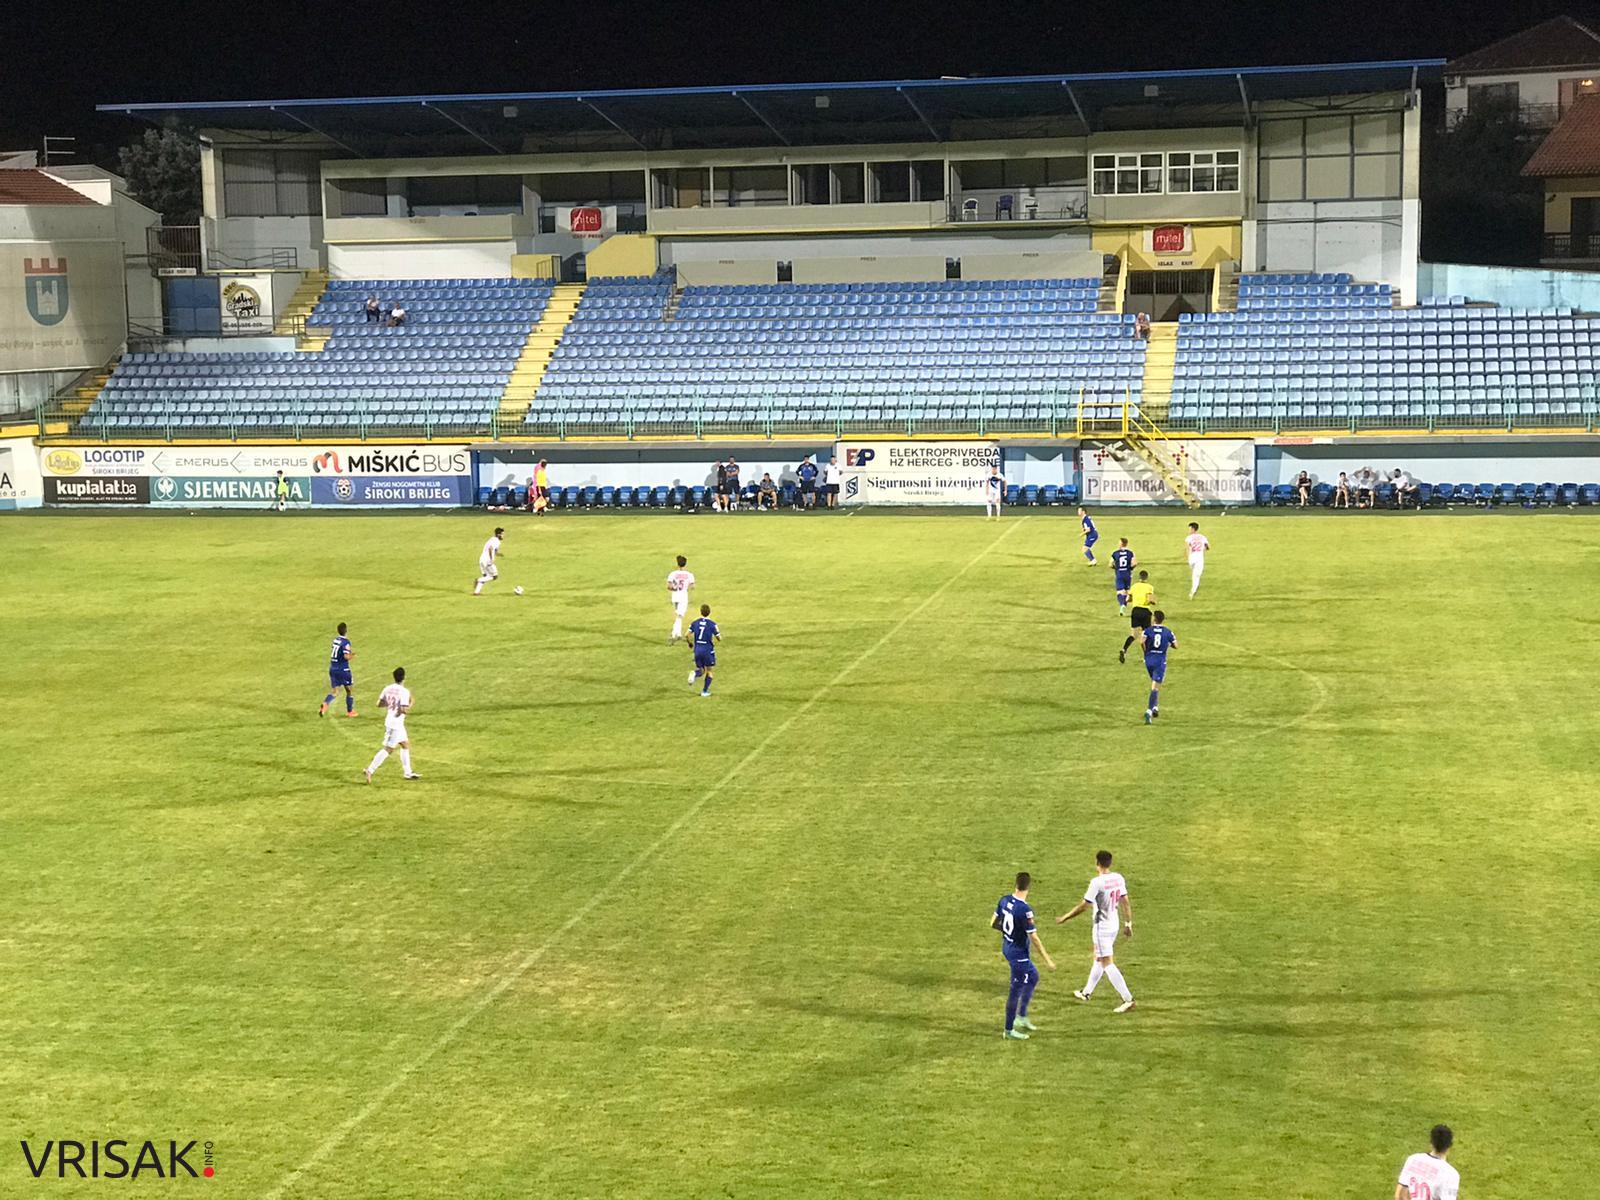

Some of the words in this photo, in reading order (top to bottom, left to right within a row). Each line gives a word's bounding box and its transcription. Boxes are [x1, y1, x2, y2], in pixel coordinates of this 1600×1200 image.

[84, 450, 145, 463] LOGOTIP
[889, 448, 1000, 458] ELEKTROPRIVREDA
[175, 458, 229, 468] EMERUS
[254, 458, 308, 468] EMERUS
[889, 458, 905, 467] HZ
[907, 458, 953, 467] HERCEG
[962, 458, 1000, 467] BOSNE
[56, 480, 137, 497] kupialat.ba
[391, 481, 426, 489] NOGOMETNI
[426, 481, 441, 489] KLUB
[867, 476, 932, 490] Sigurnosni
[1103, 479, 1166, 492] PRIMORKA
[1188, 479, 1252, 492] PRIMORKA
[184, 481, 303, 499] SJEMENARA
[364, 487, 405, 500] ŠIROKI
[408, 488, 451, 500] BRIJEG
[698, 626, 706, 640] 7
[1153, 633, 1162, 649] 8
